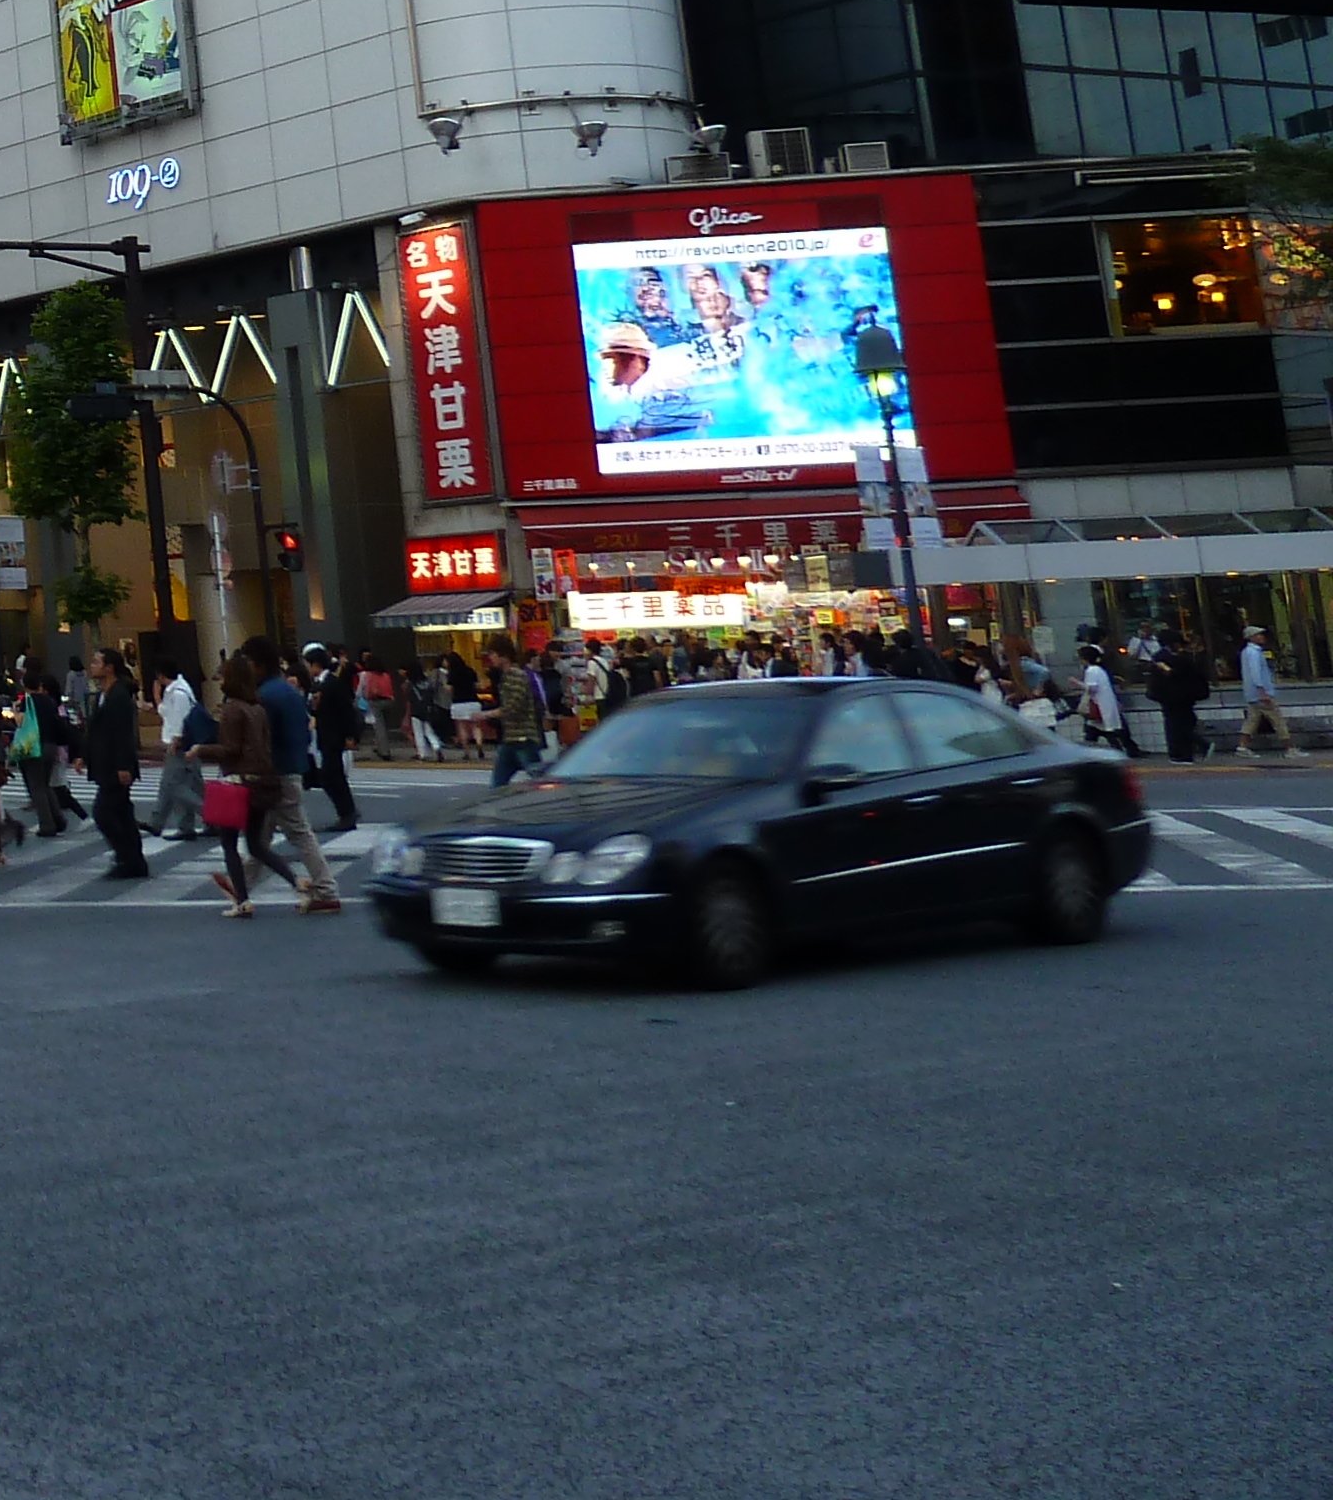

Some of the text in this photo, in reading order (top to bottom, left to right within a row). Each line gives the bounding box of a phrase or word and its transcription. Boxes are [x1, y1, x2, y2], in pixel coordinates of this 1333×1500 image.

[689, 206, 763, 234] Glico
[405, 234, 459, 268] 名物
[415, 269, 477, 489] 天津甘栗
[410, 548, 496, 578] 天津甘栗
[586, 594, 726, 621] 三千里薬品
